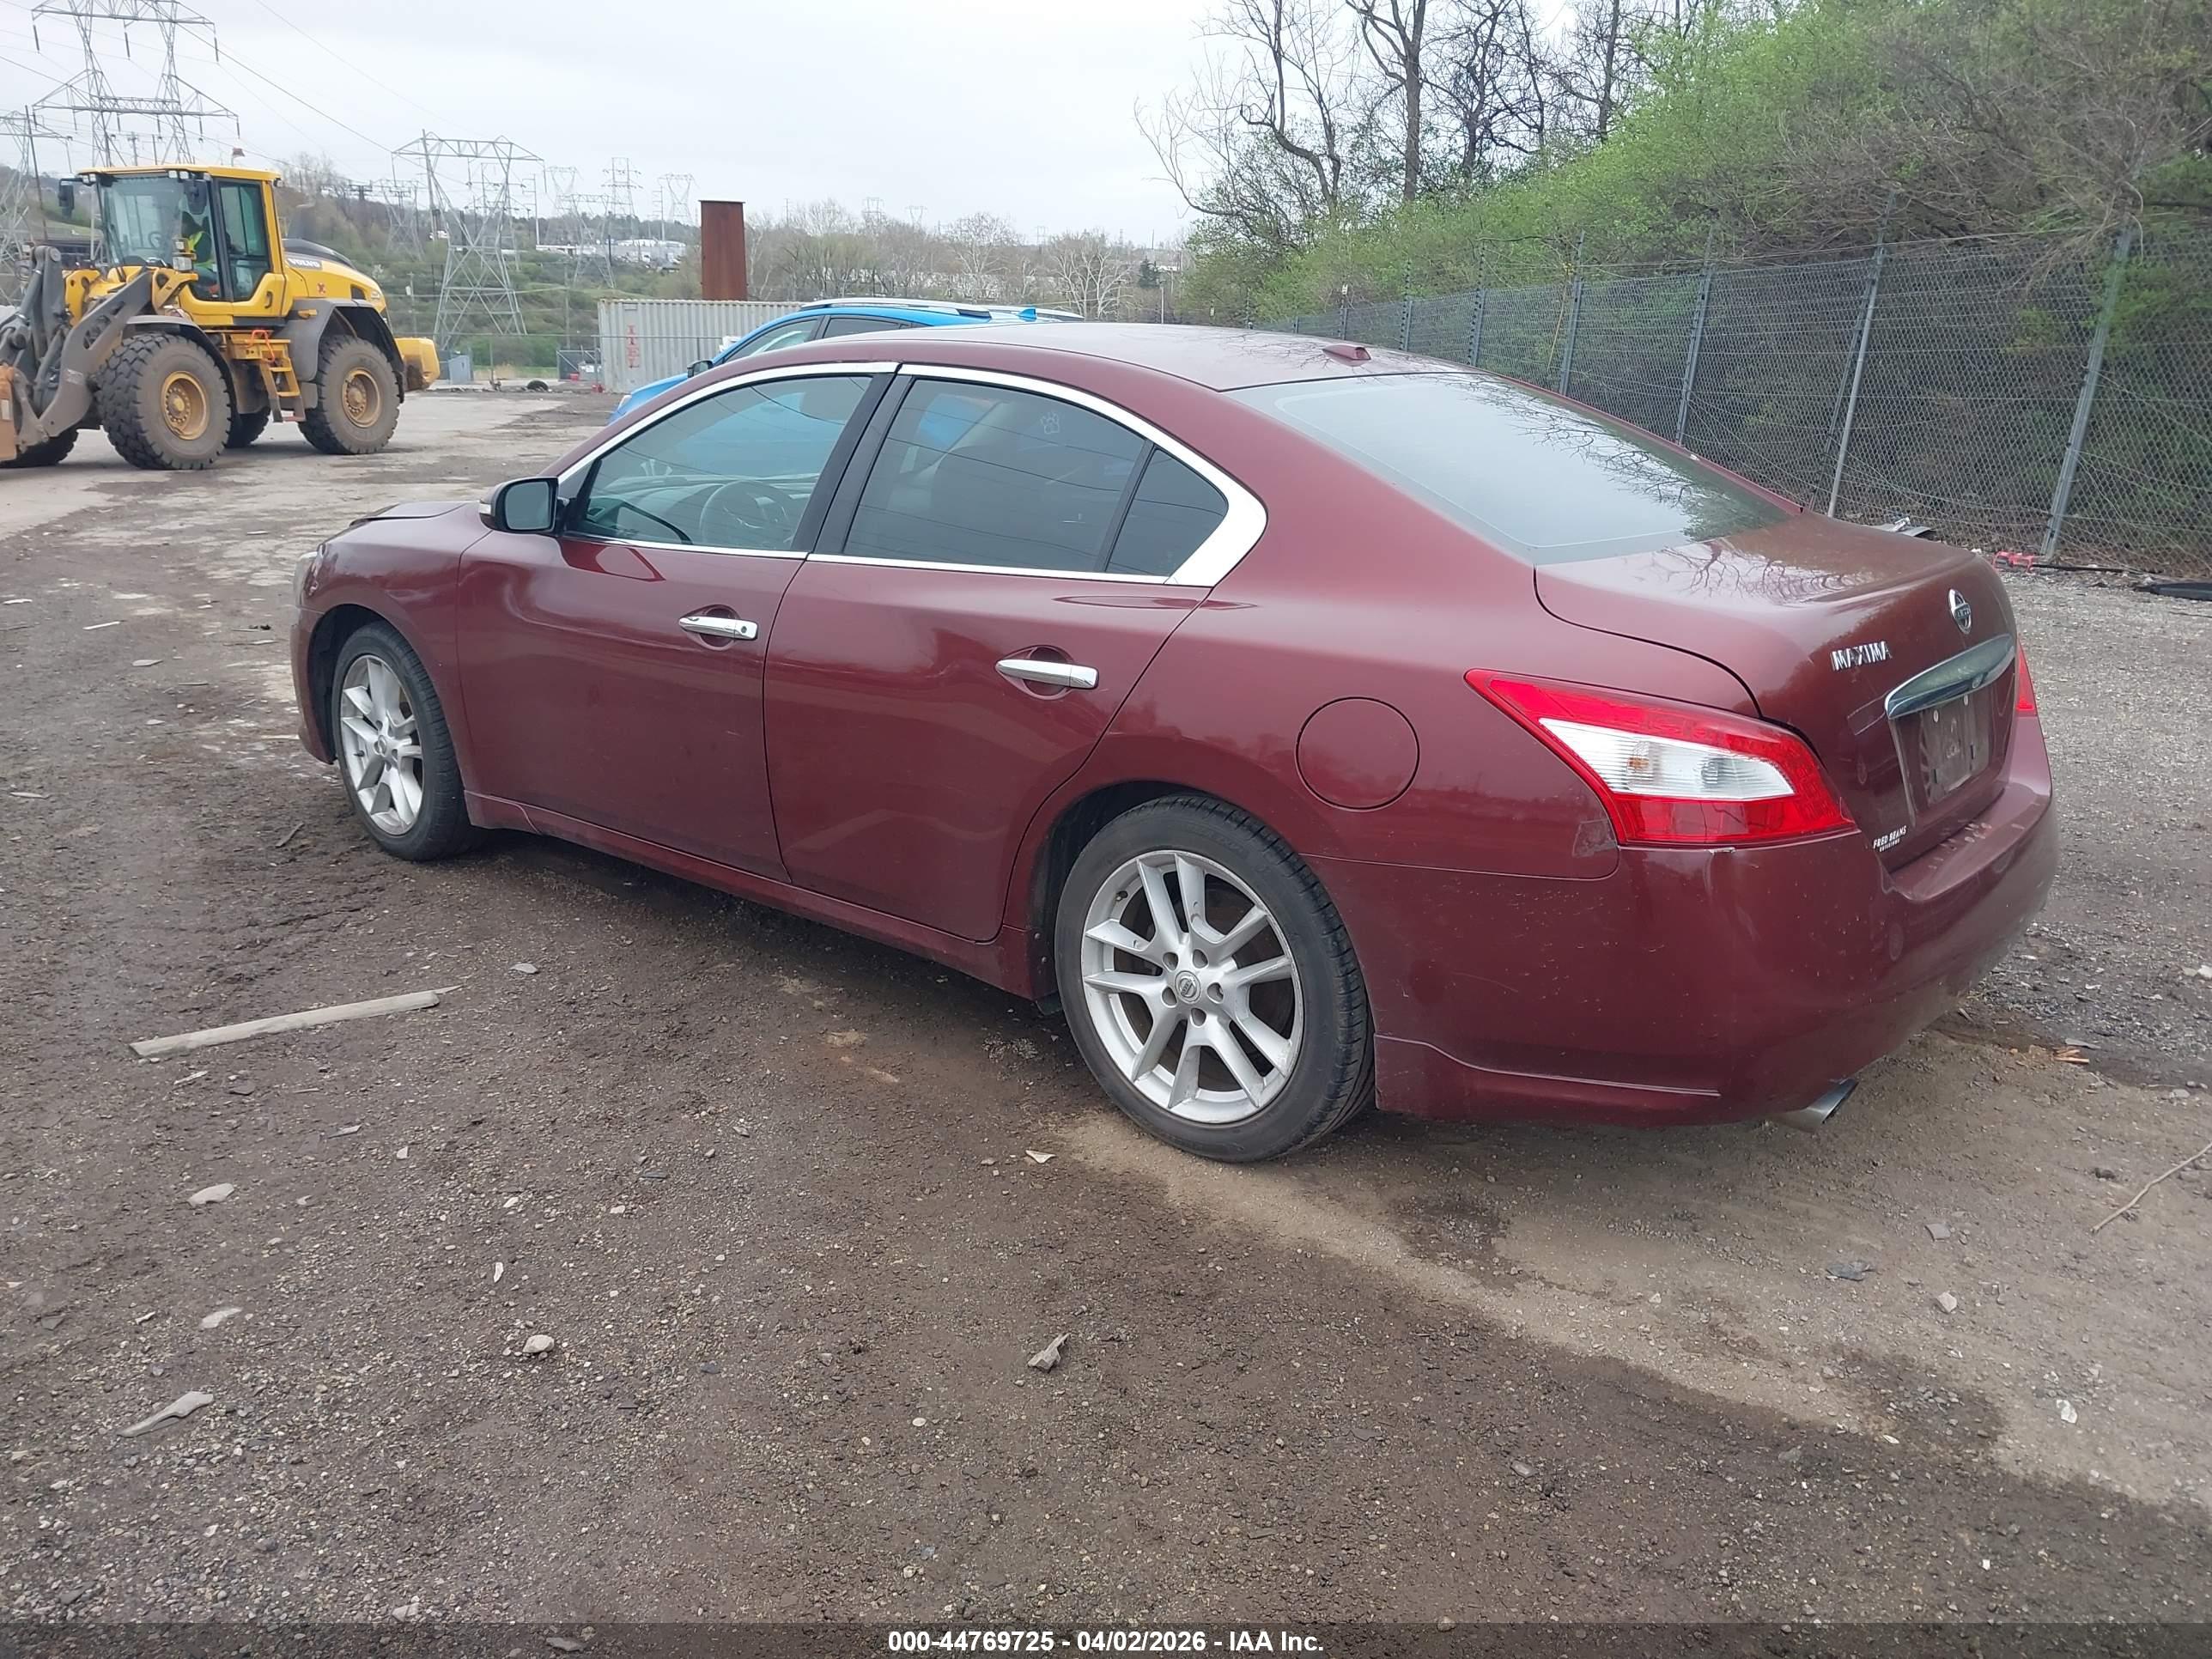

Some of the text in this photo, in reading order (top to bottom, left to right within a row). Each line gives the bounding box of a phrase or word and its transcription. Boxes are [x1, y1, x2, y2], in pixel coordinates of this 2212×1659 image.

[287, 258, 322, 268] VOLVO
[1830, 641, 1893, 671] MAXIMA
[1873, 835, 1888, 849] FRED
